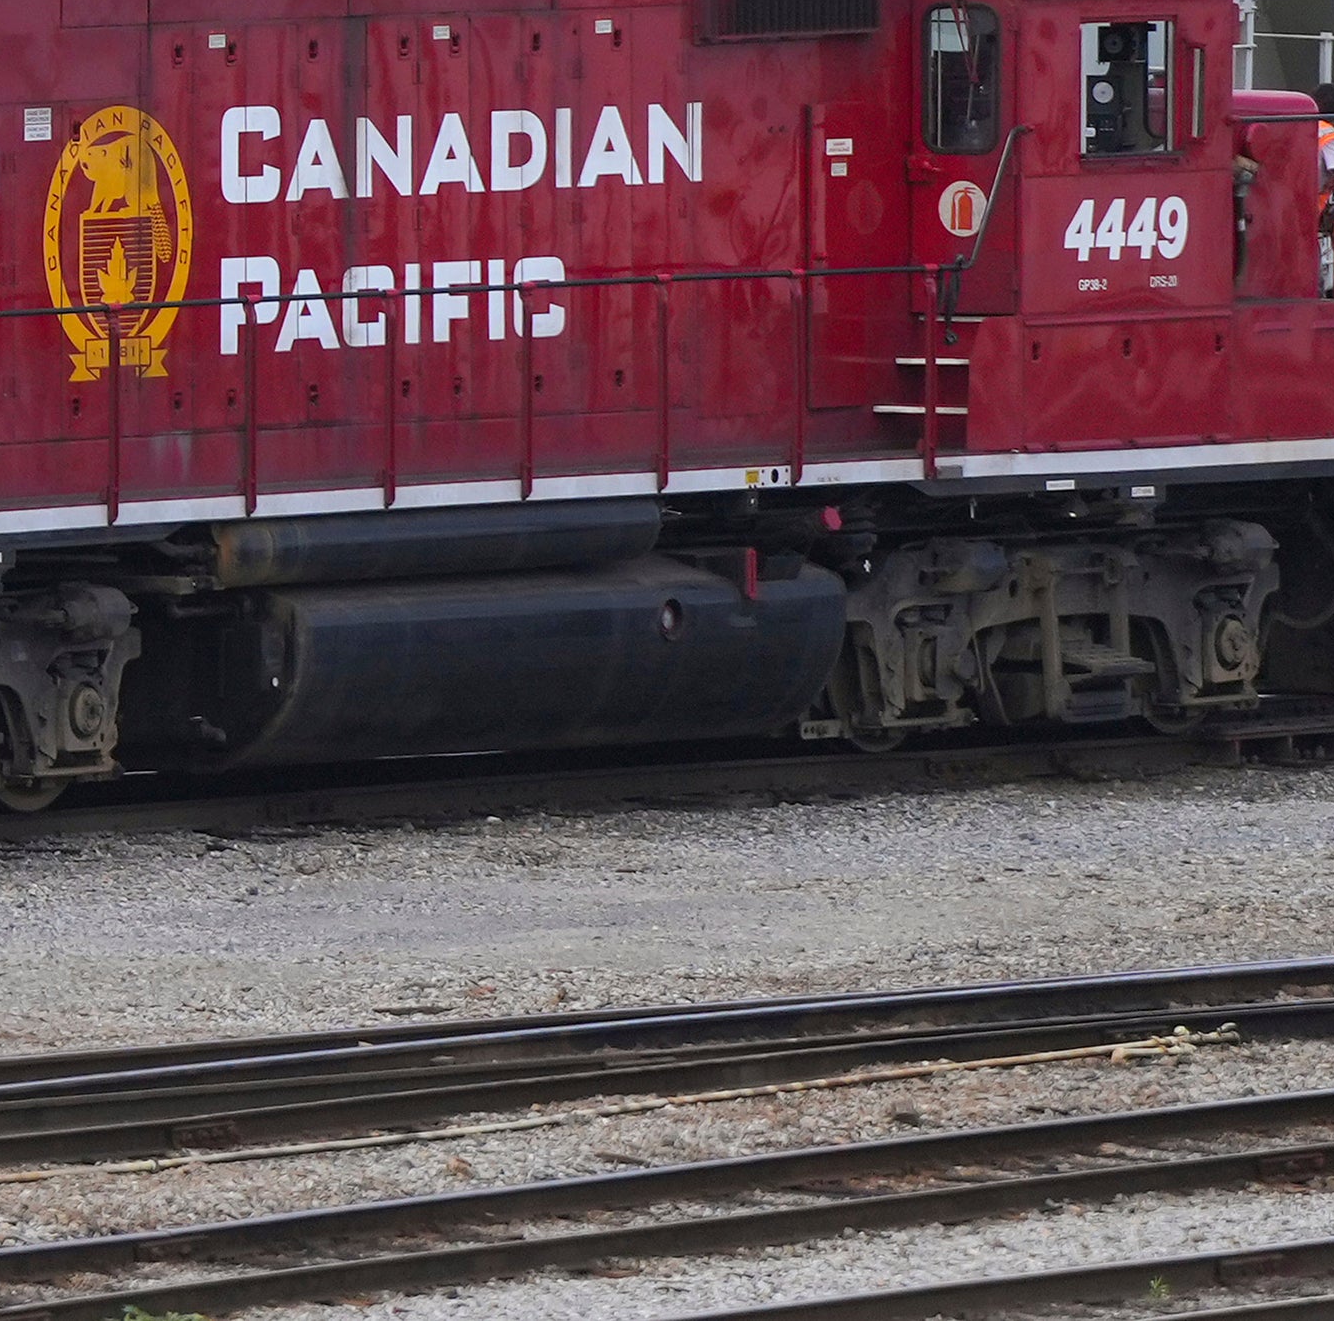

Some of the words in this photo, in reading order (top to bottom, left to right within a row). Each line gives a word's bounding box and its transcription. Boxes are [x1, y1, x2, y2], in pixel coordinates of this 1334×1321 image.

[220, 102, 703, 204] CANADIAN
[1063, 195, 1189, 262] 4449
[220, 255, 566, 355] PACIFIC
